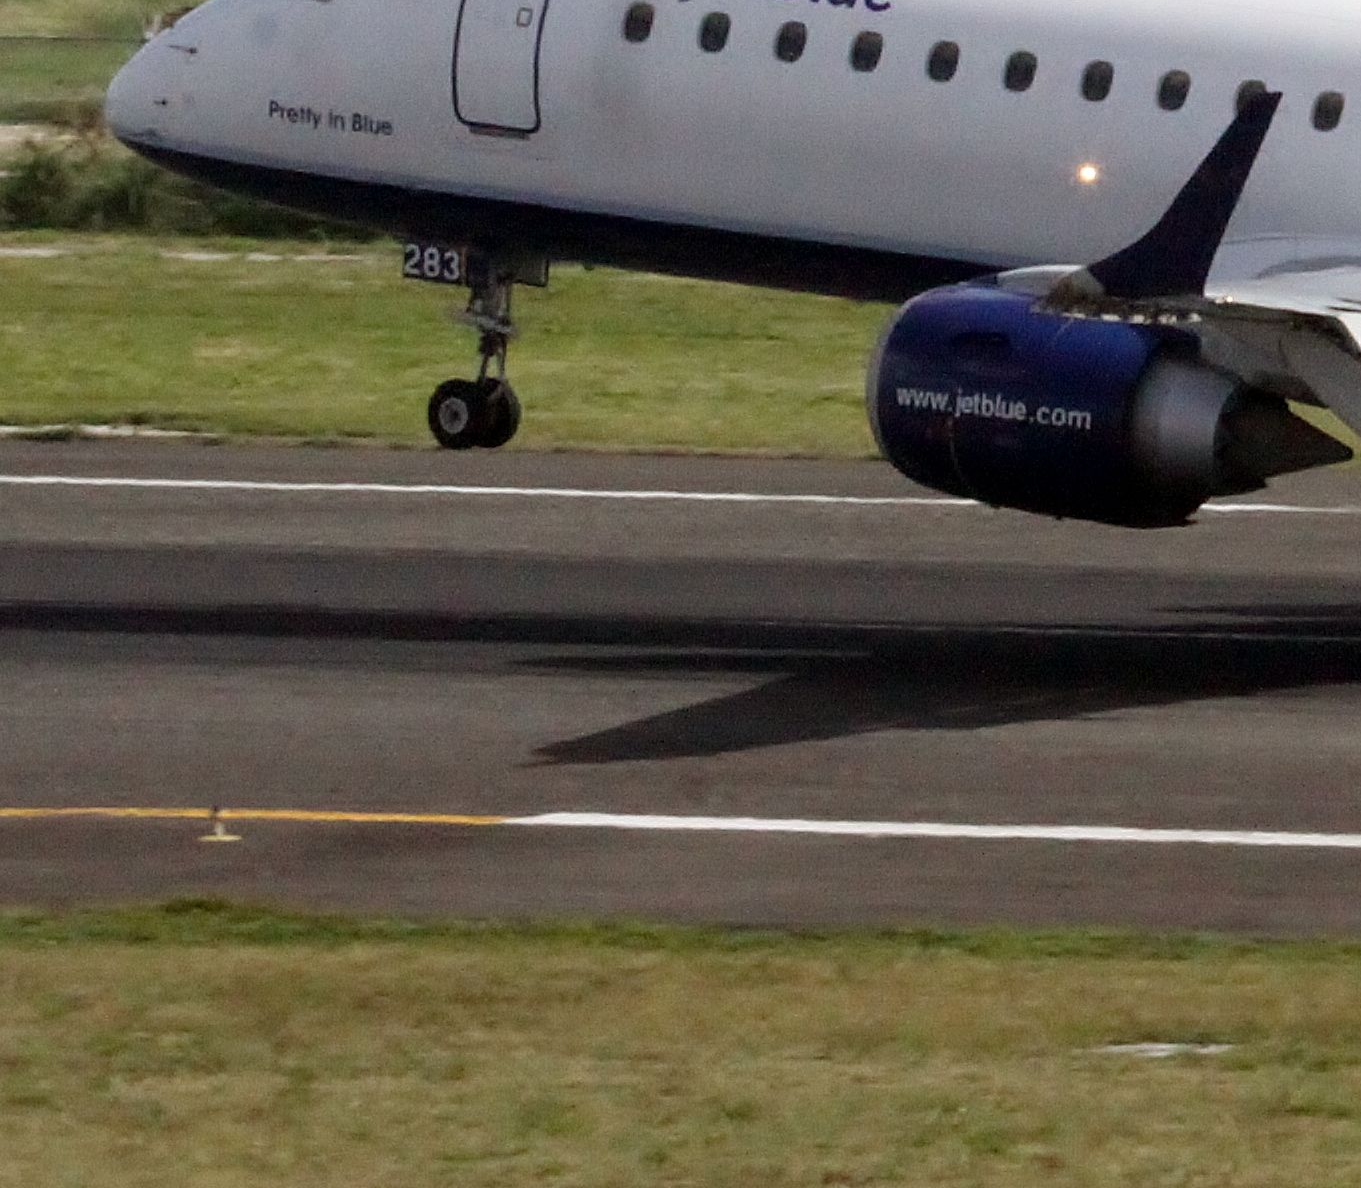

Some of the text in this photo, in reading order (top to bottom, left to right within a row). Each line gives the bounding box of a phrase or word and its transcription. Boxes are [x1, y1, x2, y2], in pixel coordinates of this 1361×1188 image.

[268, 99, 321, 130] Pretty
[351, 112, 394, 136] Blue
[404, 243, 460, 281] 283
[896, 387, 1092, 430] www.jetblue.com
